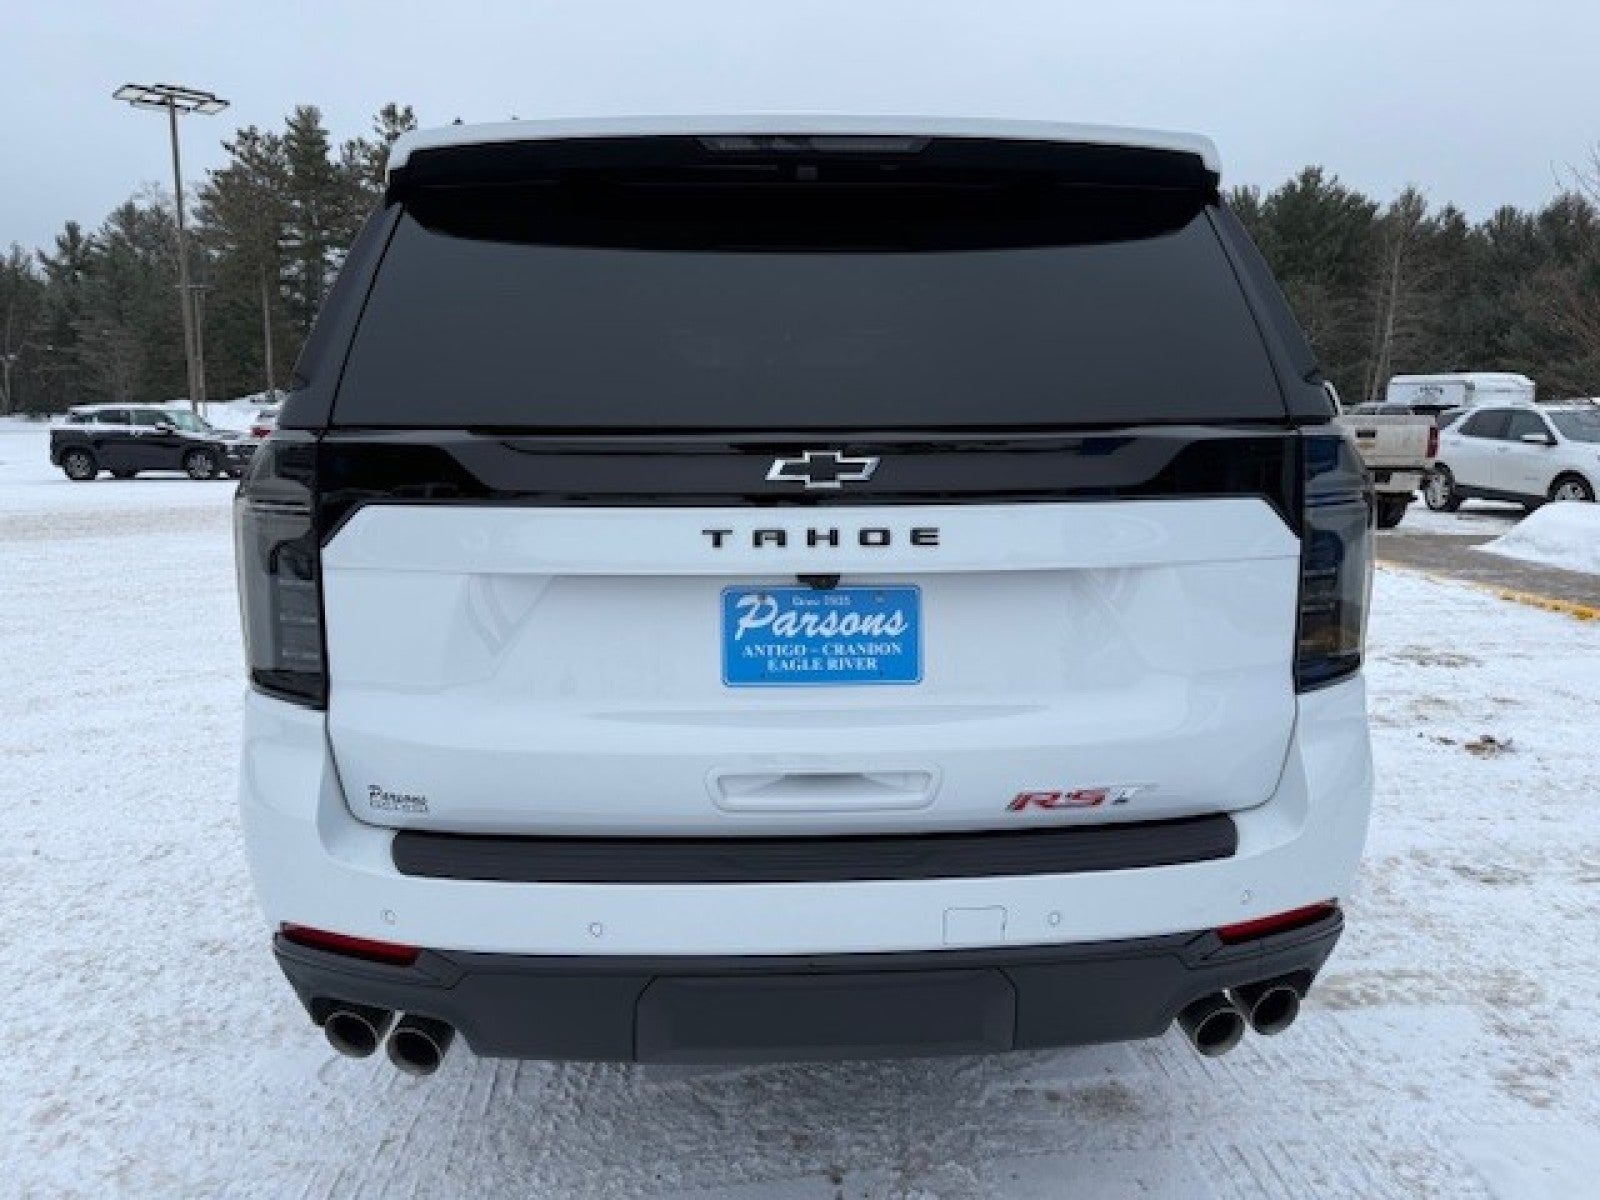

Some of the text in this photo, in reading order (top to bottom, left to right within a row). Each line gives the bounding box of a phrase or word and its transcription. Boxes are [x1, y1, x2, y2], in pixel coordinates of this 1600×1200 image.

[701, 528, 940, 548] TAHOE
[734, 594, 908, 641] Parsons
[743, 643, 807, 658] ANTIGO
[767, 656, 878, 671] EAGLE RIVER
